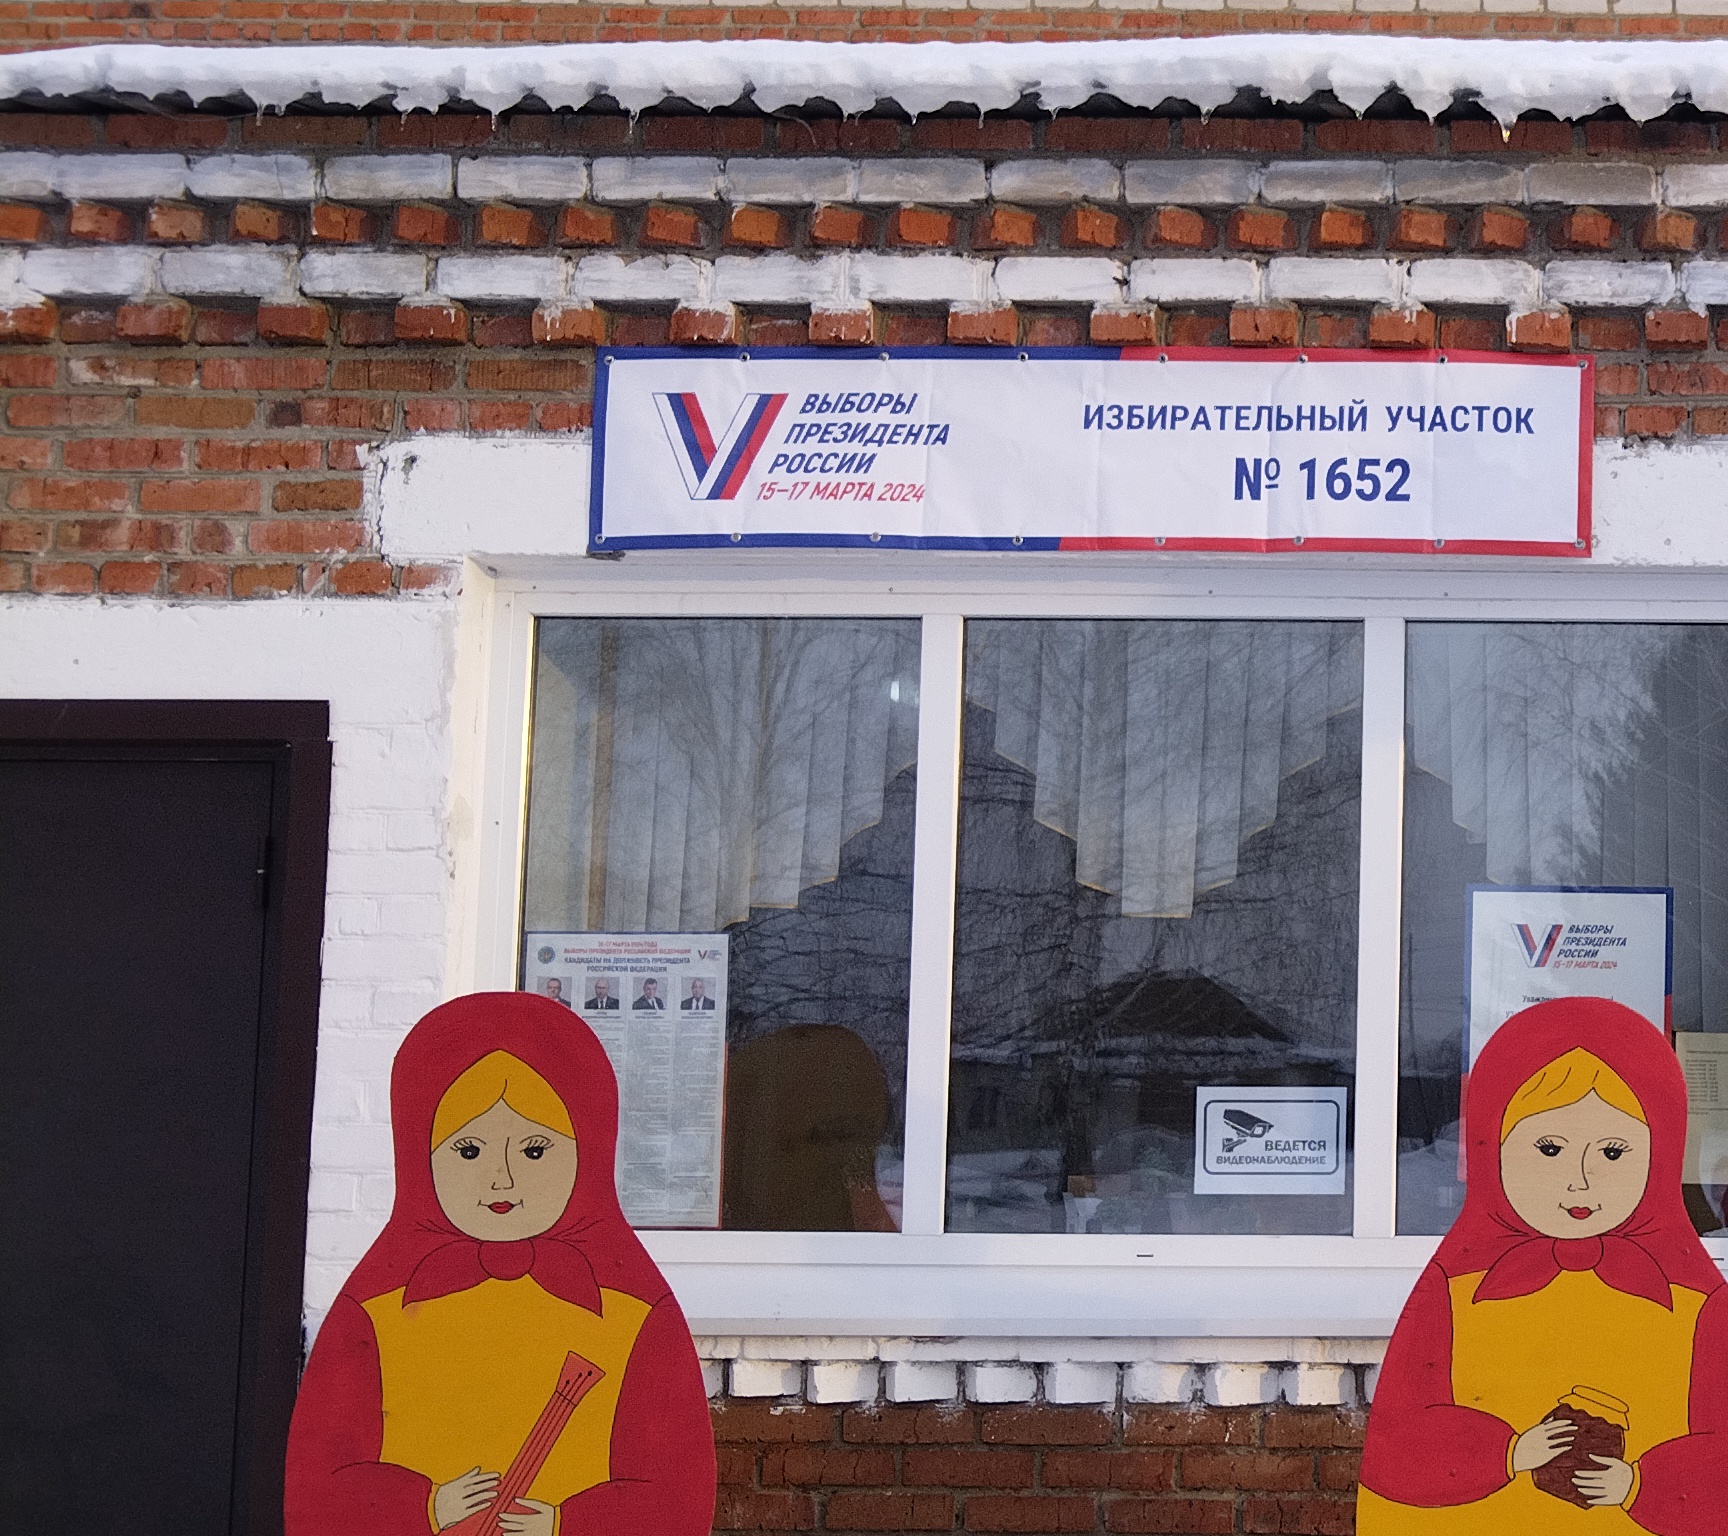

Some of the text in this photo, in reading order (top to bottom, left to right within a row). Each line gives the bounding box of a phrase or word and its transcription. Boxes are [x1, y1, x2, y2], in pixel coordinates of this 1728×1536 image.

[799, 392, 918, 414] ВЫБОРЫ
[1083, 399, 1534, 434] ИЗБИРАТЕЛЬНЫЙ УЧАСТОК
[784, 422, 950, 447] ПРЕЗИДЕНТА
[768, 452, 878, 475] РОССИИ
[1234, 457, 1411, 502] № 1652
[809, 481, 875, 502] МАРТА
[877, 483, 926, 503] 2024
[1567, 924, 1614, 934] ВЫБОРЫ
[1562, 936, 1627, 947] ПРЕЗИДЕНТА
[1557, 949, 1599, 959] РОССИИ
[1573, 960, 1599, 969] МАРТА
[1265, 1140, 1327, 1153] ВЕДЕТСЯ
[1216, 1155, 1327, 1166] ВИДЕОНАБЛЮДЕНИЕ
